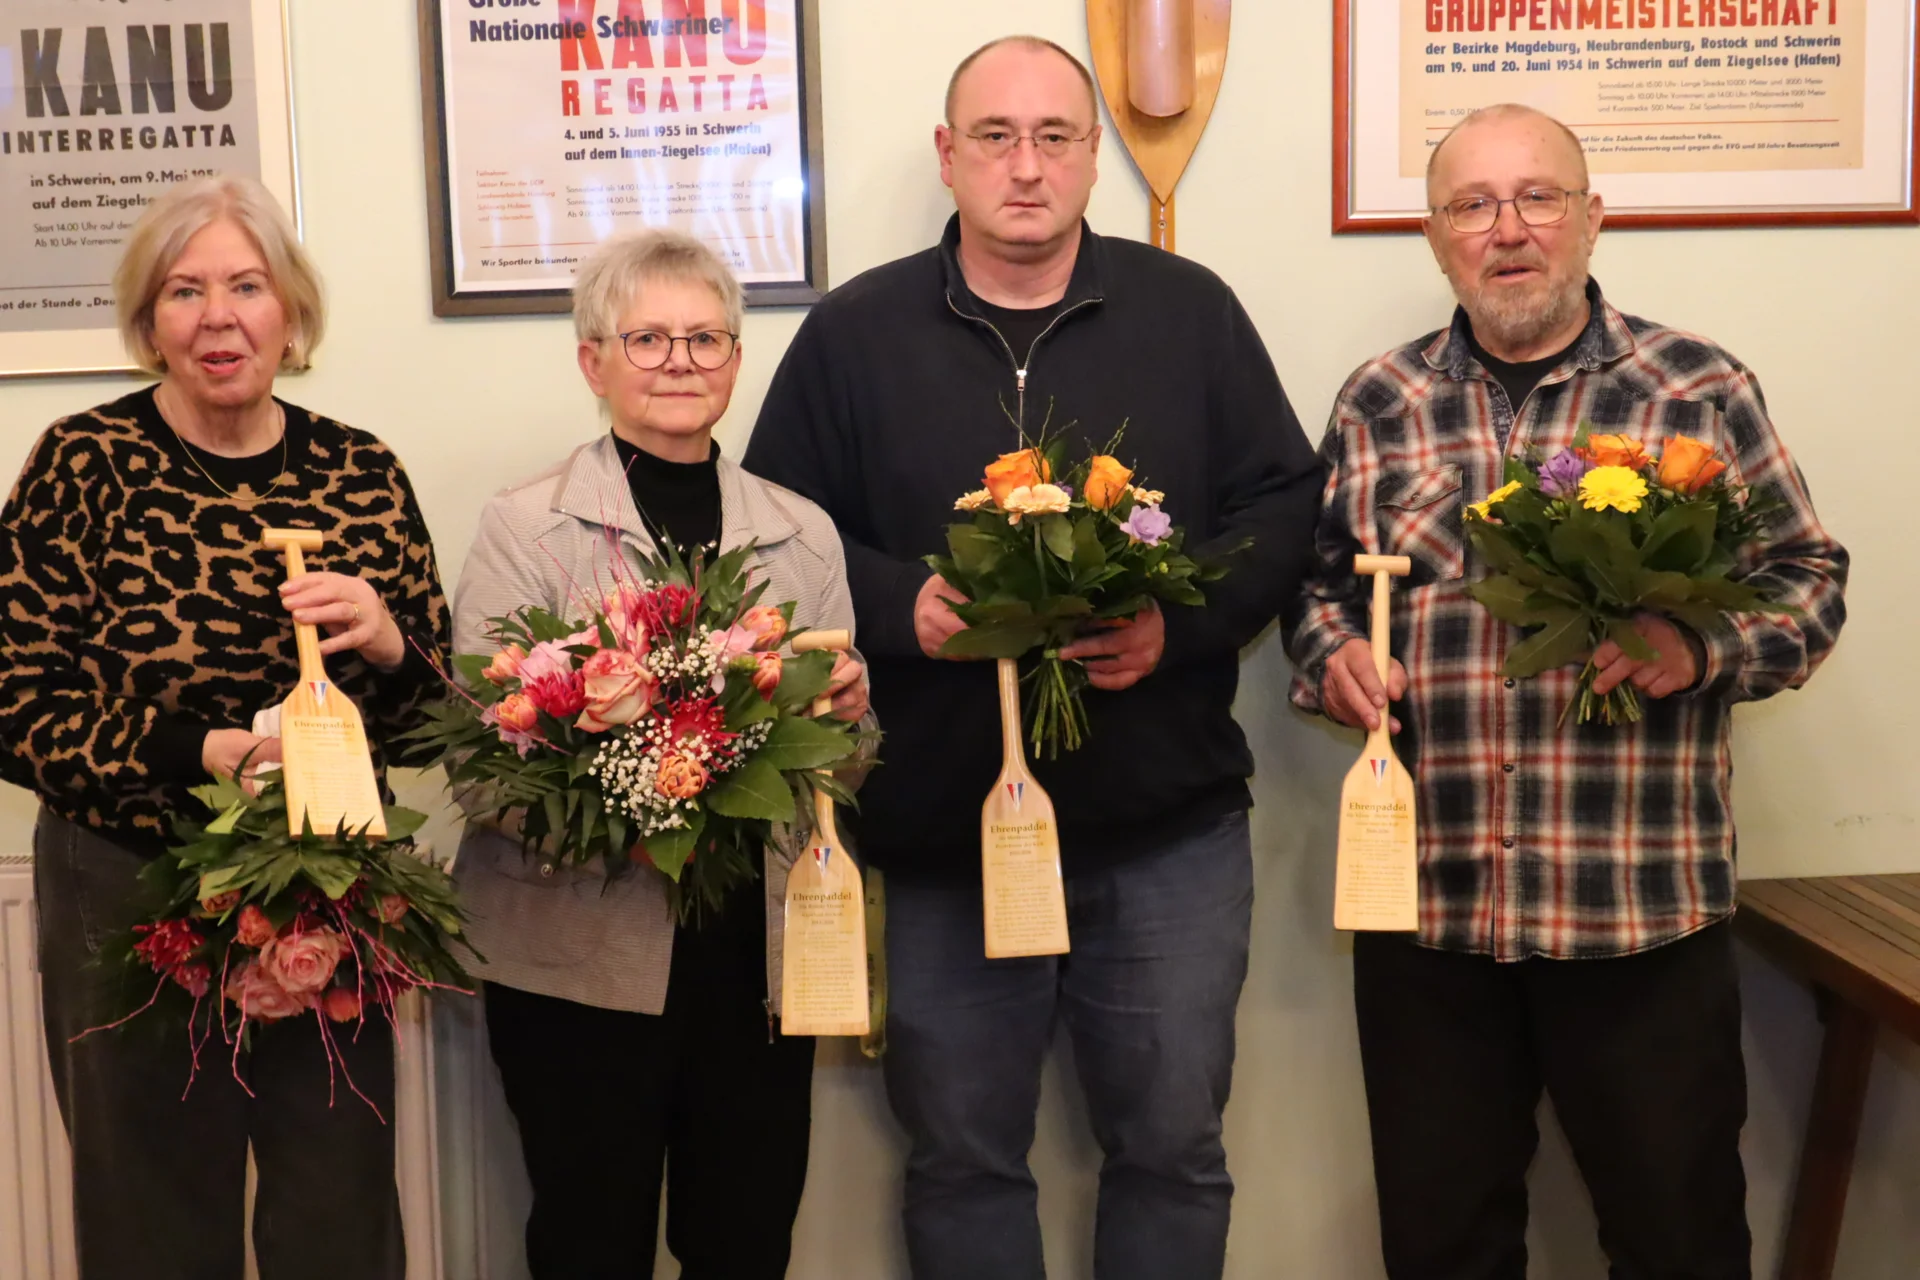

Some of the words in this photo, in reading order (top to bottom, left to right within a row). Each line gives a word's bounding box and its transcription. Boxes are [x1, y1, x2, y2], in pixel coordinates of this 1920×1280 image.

[469, 18, 587, 42] Nationale
[597, 14, 735, 38] Schweriner
[556, 0, 768, 71] KANU
[1425, 43, 1446, 56] der
[1452, 42, 1500, 55] Bezirke
[1505, 40, 1581, 56] Magdeburg,
[1586, 38, 1696, 53] Neubrandenburg,
[1701, 36, 1749, 50] Rostock
[1754, 35, 1779, 48] und
[1784, 34, 1842, 49] Schwerin
[20, 22, 233, 118] KANU
[1425, 63, 1446, 74] am
[1450, 62, 1467, 73] 19.
[1472, 60, 1496, 73] und
[1501, 60, 1520, 72] 20.
[1526, 59, 1551, 72] Juni
[1556, 58, 1583, 71] 1954
[1588, 58, 1600, 70] in
[1605, 56, 1663, 70] Schwerin
[1668, 55, 1689, 68] auf
[1694, 54, 1722, 68] dem
[1726, 53, 1790, 70] Ziegelsee
[1794, 52, 1841, 68] (Hafen)
[561, 74, 769, 117] REGATTA
[3, 124, 237, 154] INTERREGATTA
[563, 129, 576, 145] 4.
[579, 127, 604, 144] und
[608, 126, 621, 142] 5.
[623, 124, 650, 141] Juni
[654, 124, 681, 140] 1955
[686, 122, 698, 138] in
[702, 120, 762, 138] Schwerin
[565, 148, 587, 161] auf
[590, 147, 618, 160] dem
[620, 143, 720, 161] Innen-Ziegelsee
[724, 142, 773, 159] (Hafen)
[30, 174, 43, 187] in
[47, 172, 116, 188] Schwerin,
[119, 173, 142, 184] am
[32, 197, 56, 209] auf
[61, 197, 92, 208] dem
[81, 221, 98, 231] Uhr
[100, 220, 115, 230] auf
[35, 238, 48, 247] Ab
[50, 238, 60, 247] 10
[62, 237, 78, 247] Uhr
[480, 259, 497, 268] Wir
[498, 257, 533, 268] Sportler
[534, 256, 580, 266] bekunden
[18, 300, 37, 309] der
[42, 298, 82, 308] Stunde
